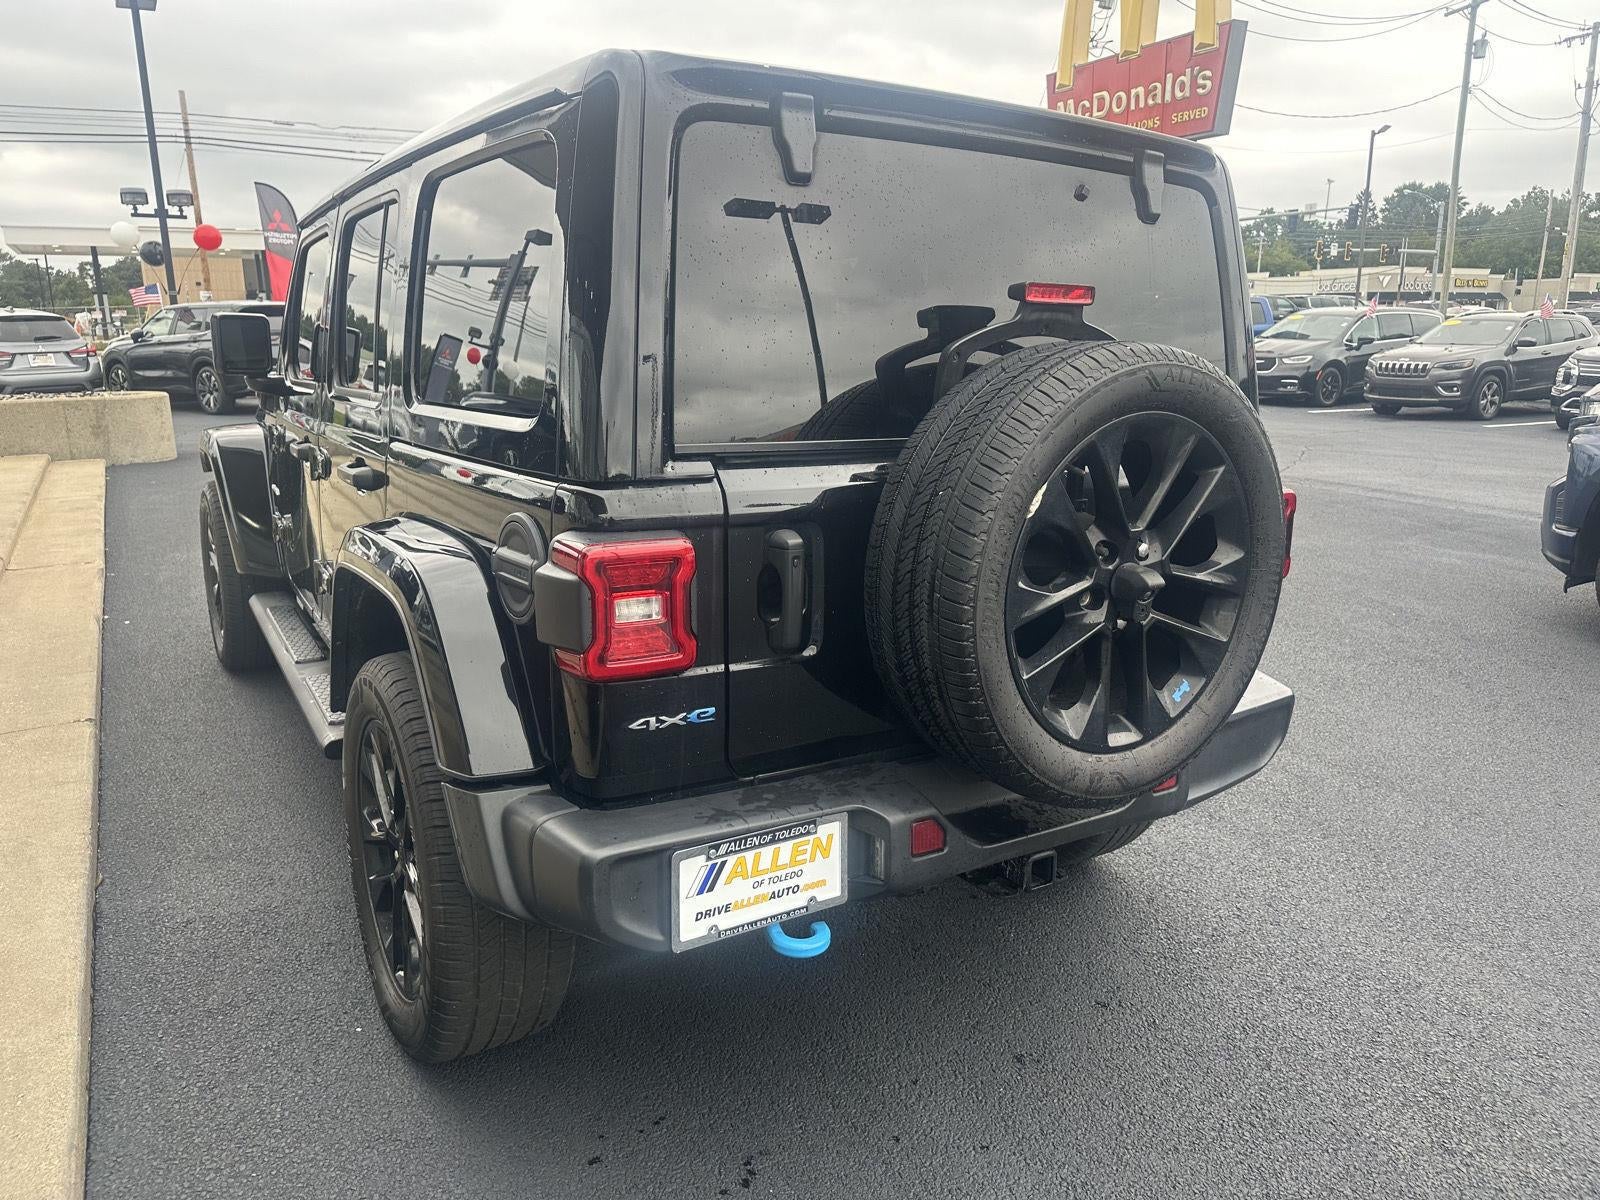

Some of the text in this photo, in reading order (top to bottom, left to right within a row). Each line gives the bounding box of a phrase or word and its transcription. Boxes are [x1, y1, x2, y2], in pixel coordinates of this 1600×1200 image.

[1056, 66, 1213, 119] McDonald's
[1171, 106, 1209, 124] SERVED
[727, 825, 809, 853] ALLEN OF TOLEDO
[724, 833, 834, 886] ALLEN
[752, 869, 804, 890] OF TOLEDO
